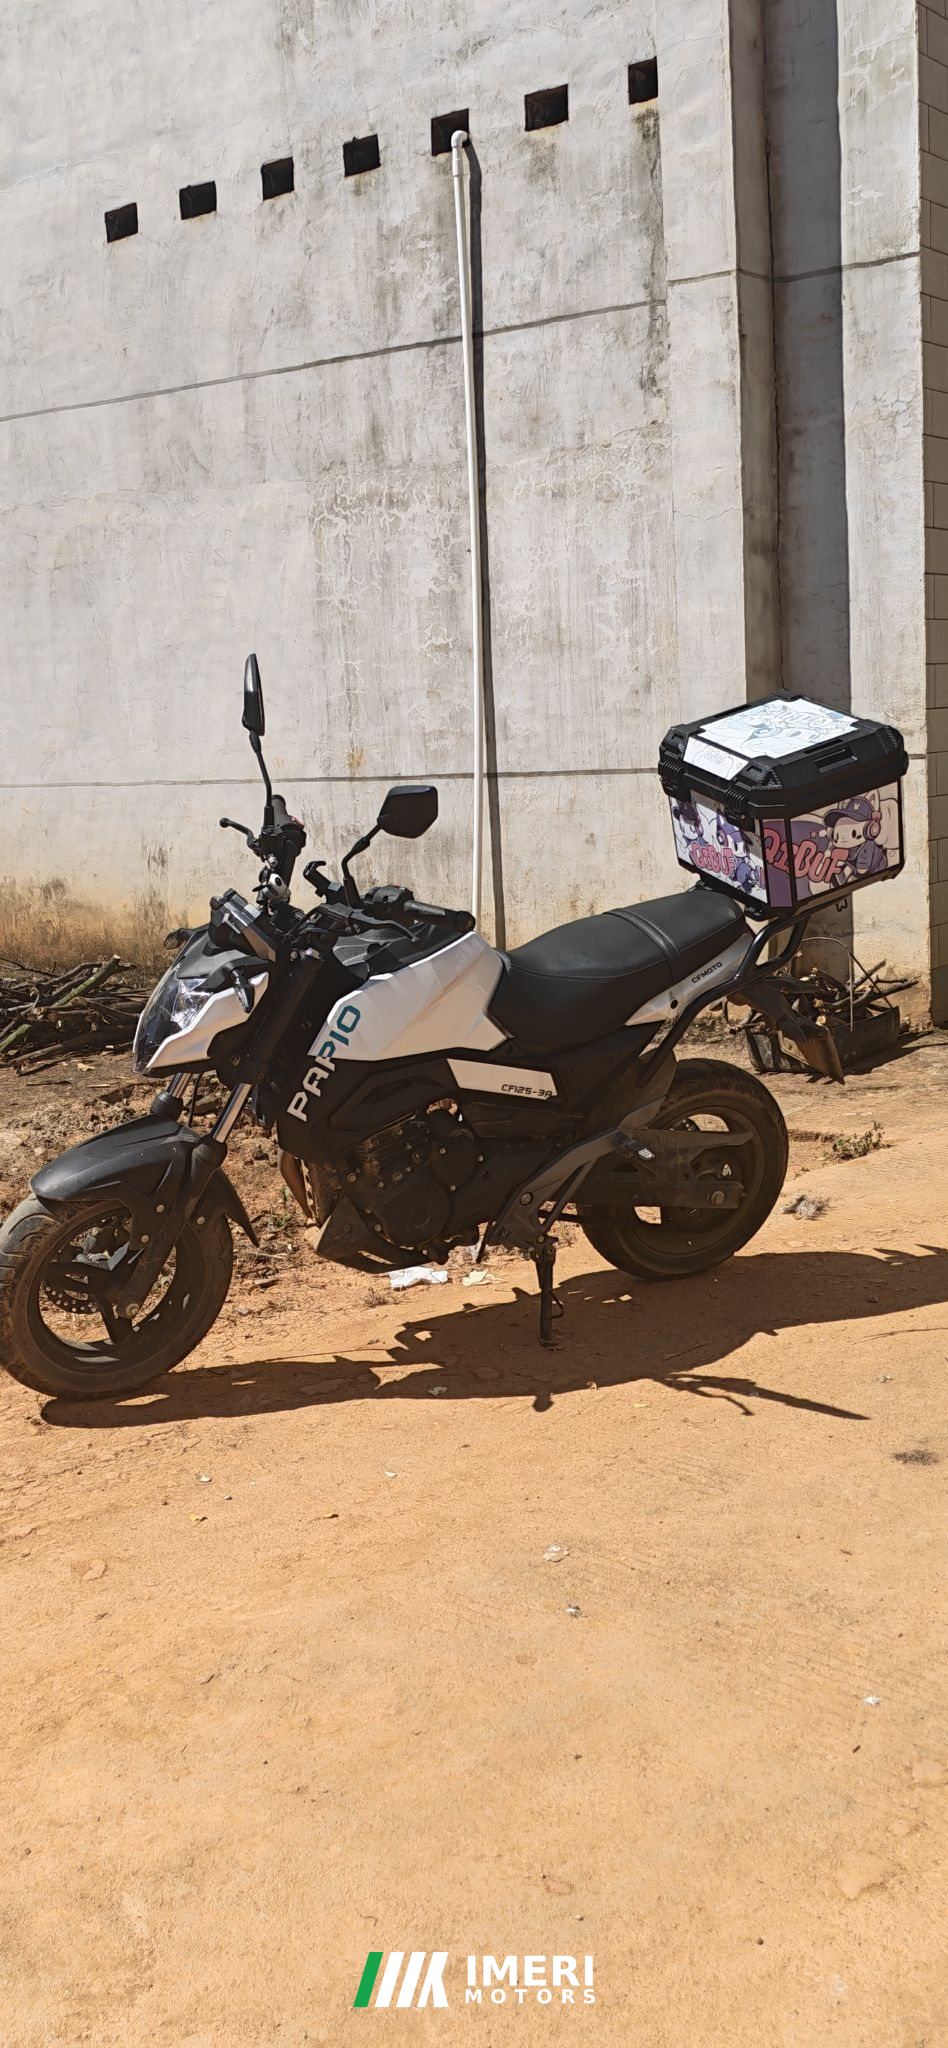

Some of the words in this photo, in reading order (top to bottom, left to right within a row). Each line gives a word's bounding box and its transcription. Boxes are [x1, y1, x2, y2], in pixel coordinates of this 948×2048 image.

[691, 961, 723, 984] CFMOTO
[286, 1005, 361, 1122] PAPIO
[501, 1083, 553, 1098] CF125-3A
